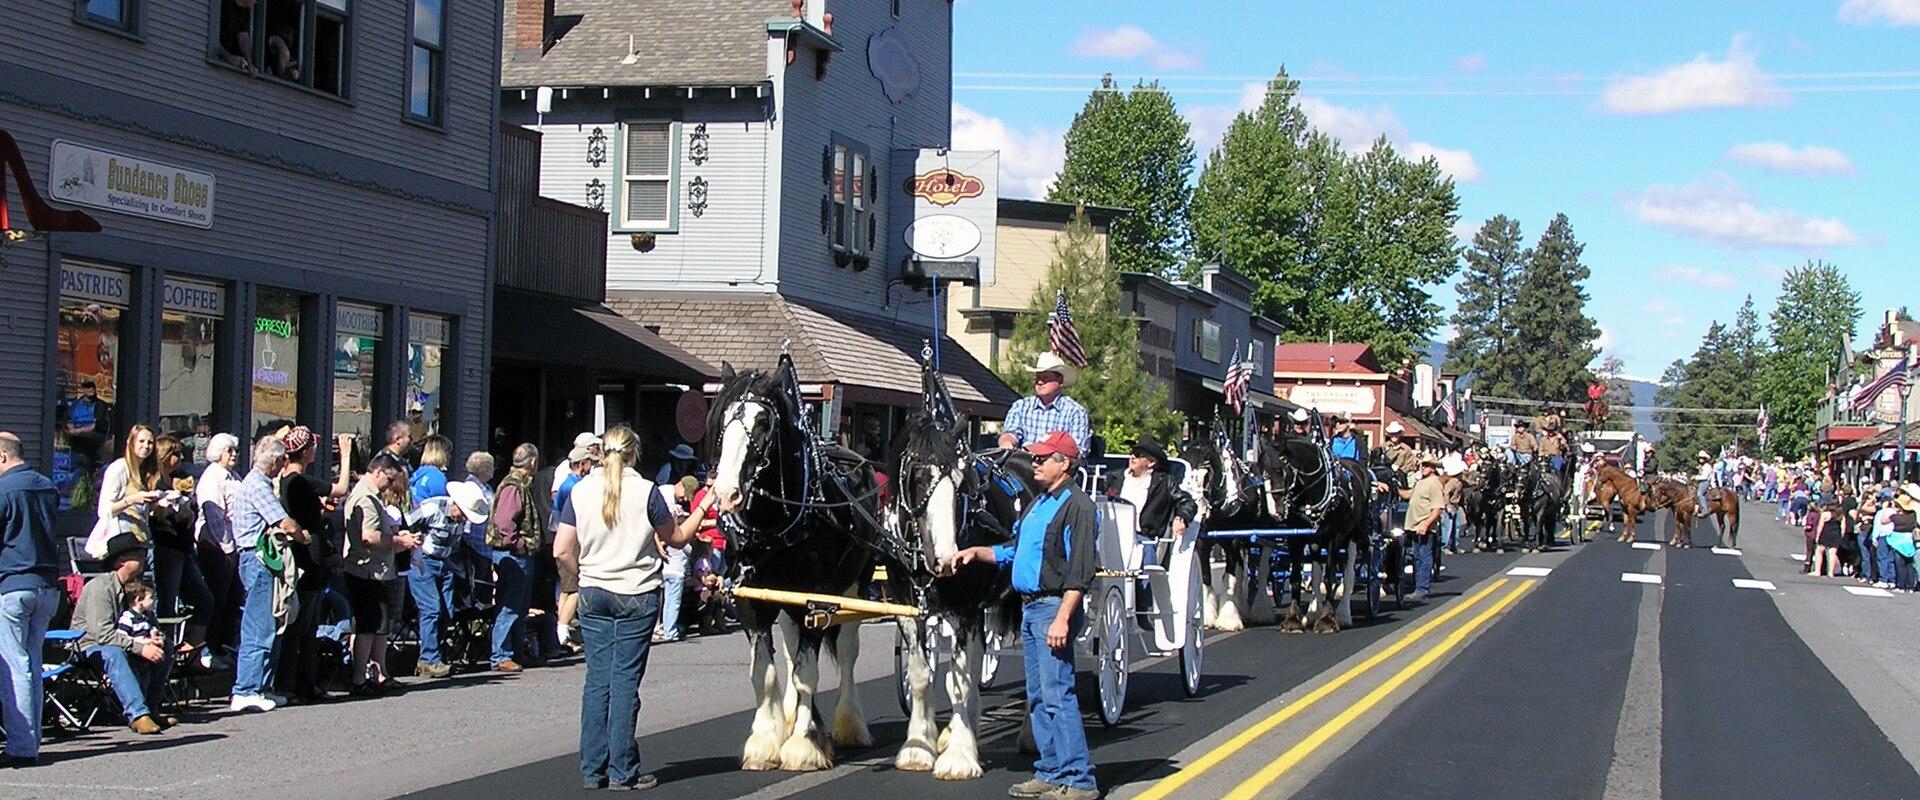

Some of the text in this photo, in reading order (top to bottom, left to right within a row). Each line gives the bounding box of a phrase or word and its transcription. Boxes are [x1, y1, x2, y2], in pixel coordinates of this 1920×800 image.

[107, 157, 209, 208] Sundance Shoes
[915, 178, 969, 193] Hotel
[107, 193, 150, 213] Specializing
[160, 204, 187, 218] Comfort
[188, 209, 206, 222] Shoes
[60, 269, 123, 298] PASTRIES
[164, 284, 218, 311] COFFEE
